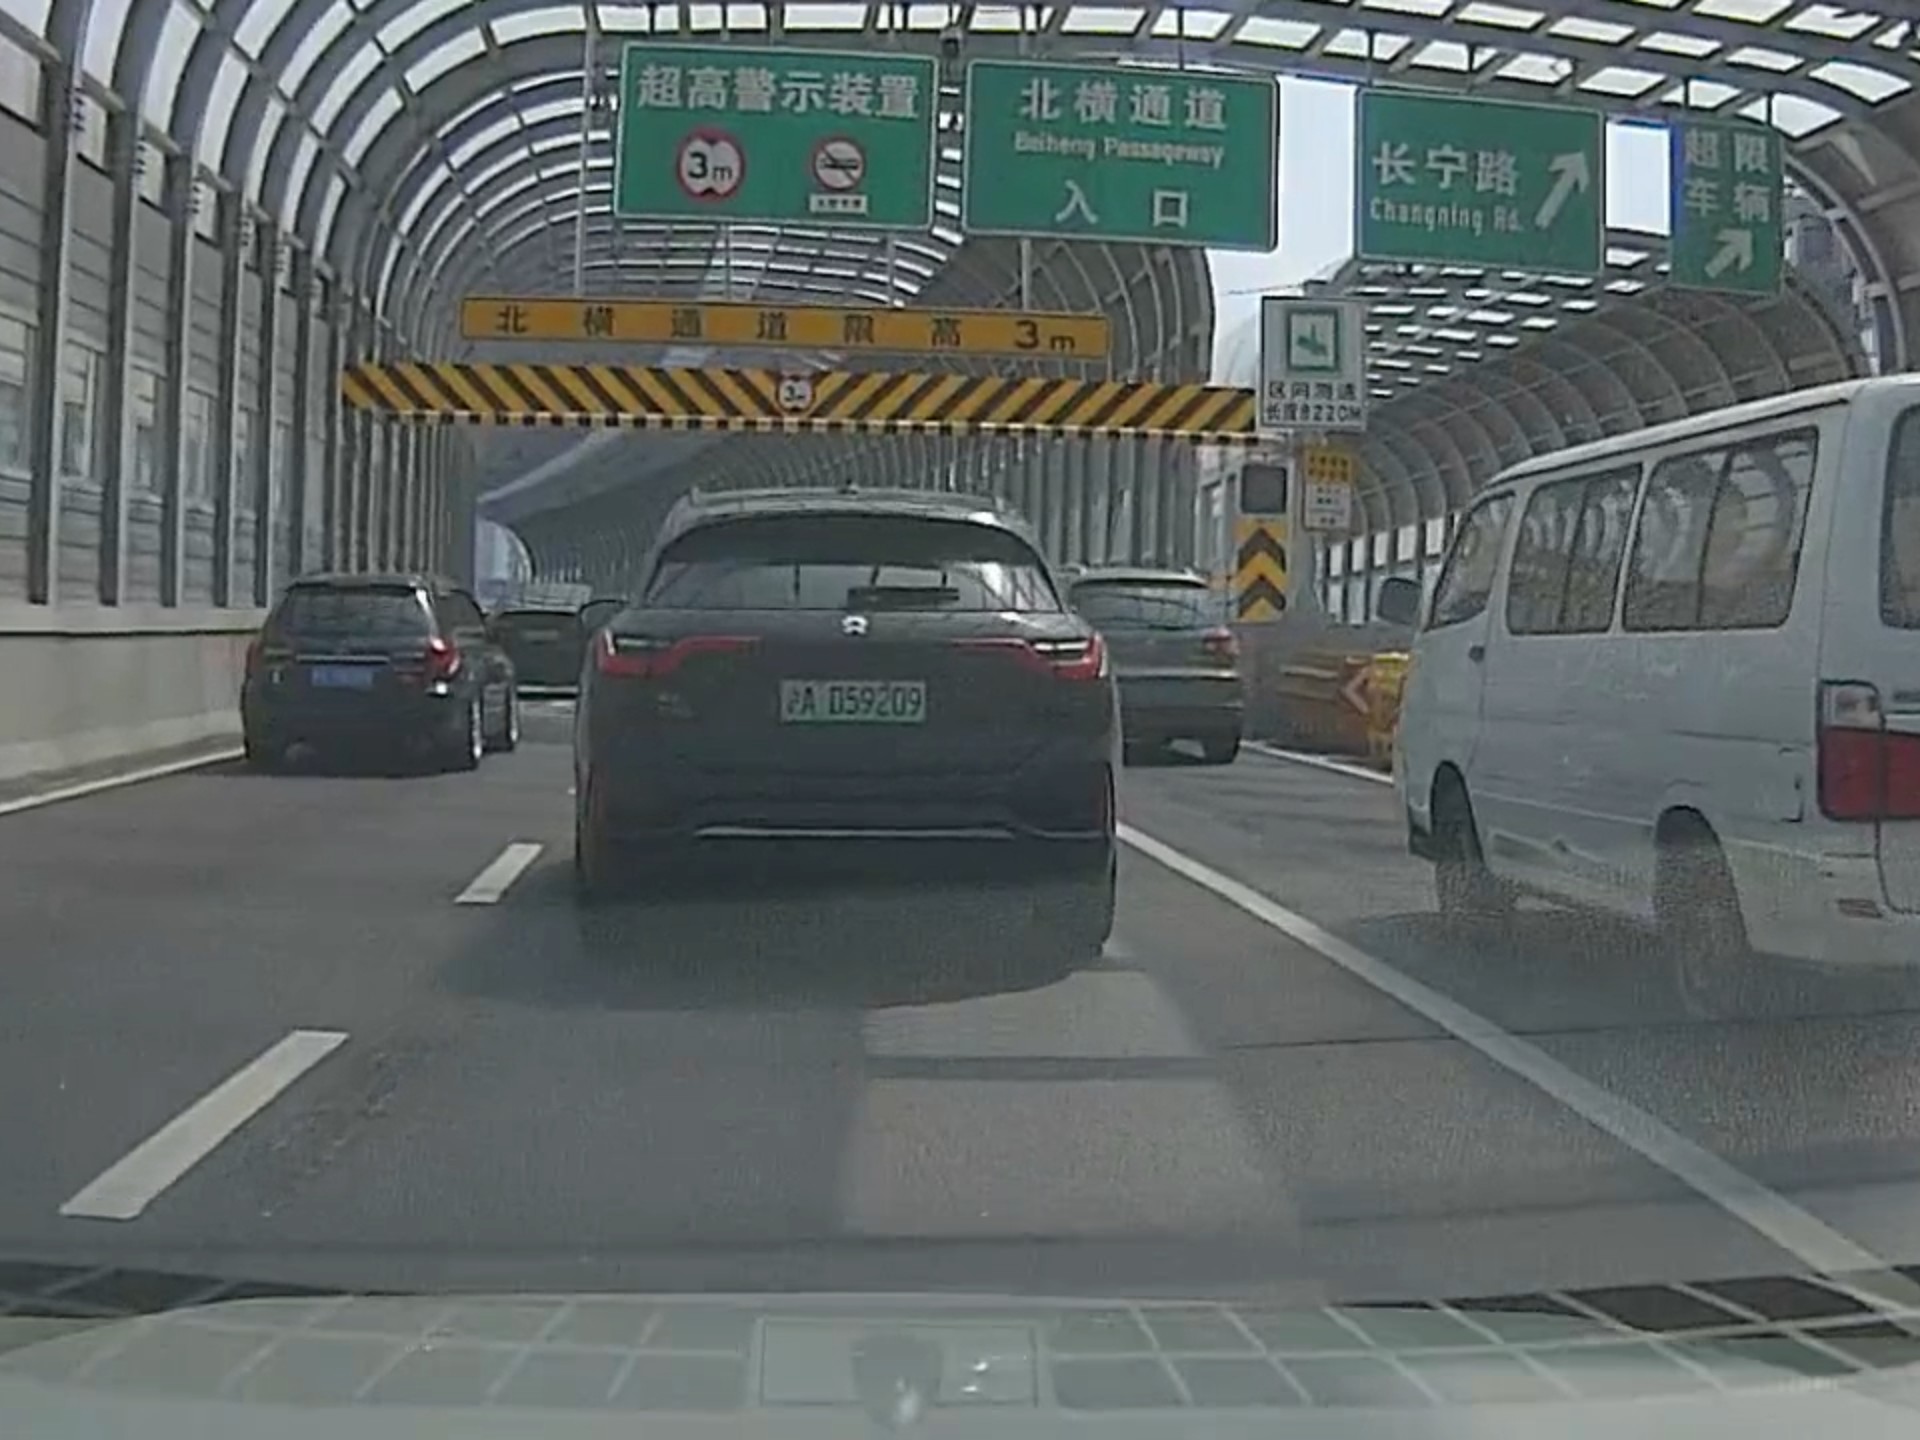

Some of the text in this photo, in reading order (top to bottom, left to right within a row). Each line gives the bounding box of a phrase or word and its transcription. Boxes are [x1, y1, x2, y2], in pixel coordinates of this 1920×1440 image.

[637, 63, 919, 118] 超高警示装置
[1019, 77, 1227, 131] 北横通道
[1372, 140, 1519, 197] 长宁路
[1684, 127, 1770, 174] 超限
[1055, 180, 1189, 229] 入口
[1369, 196, 1483, 236] Changning
[1684, 177, 1771, 223] 车辆
